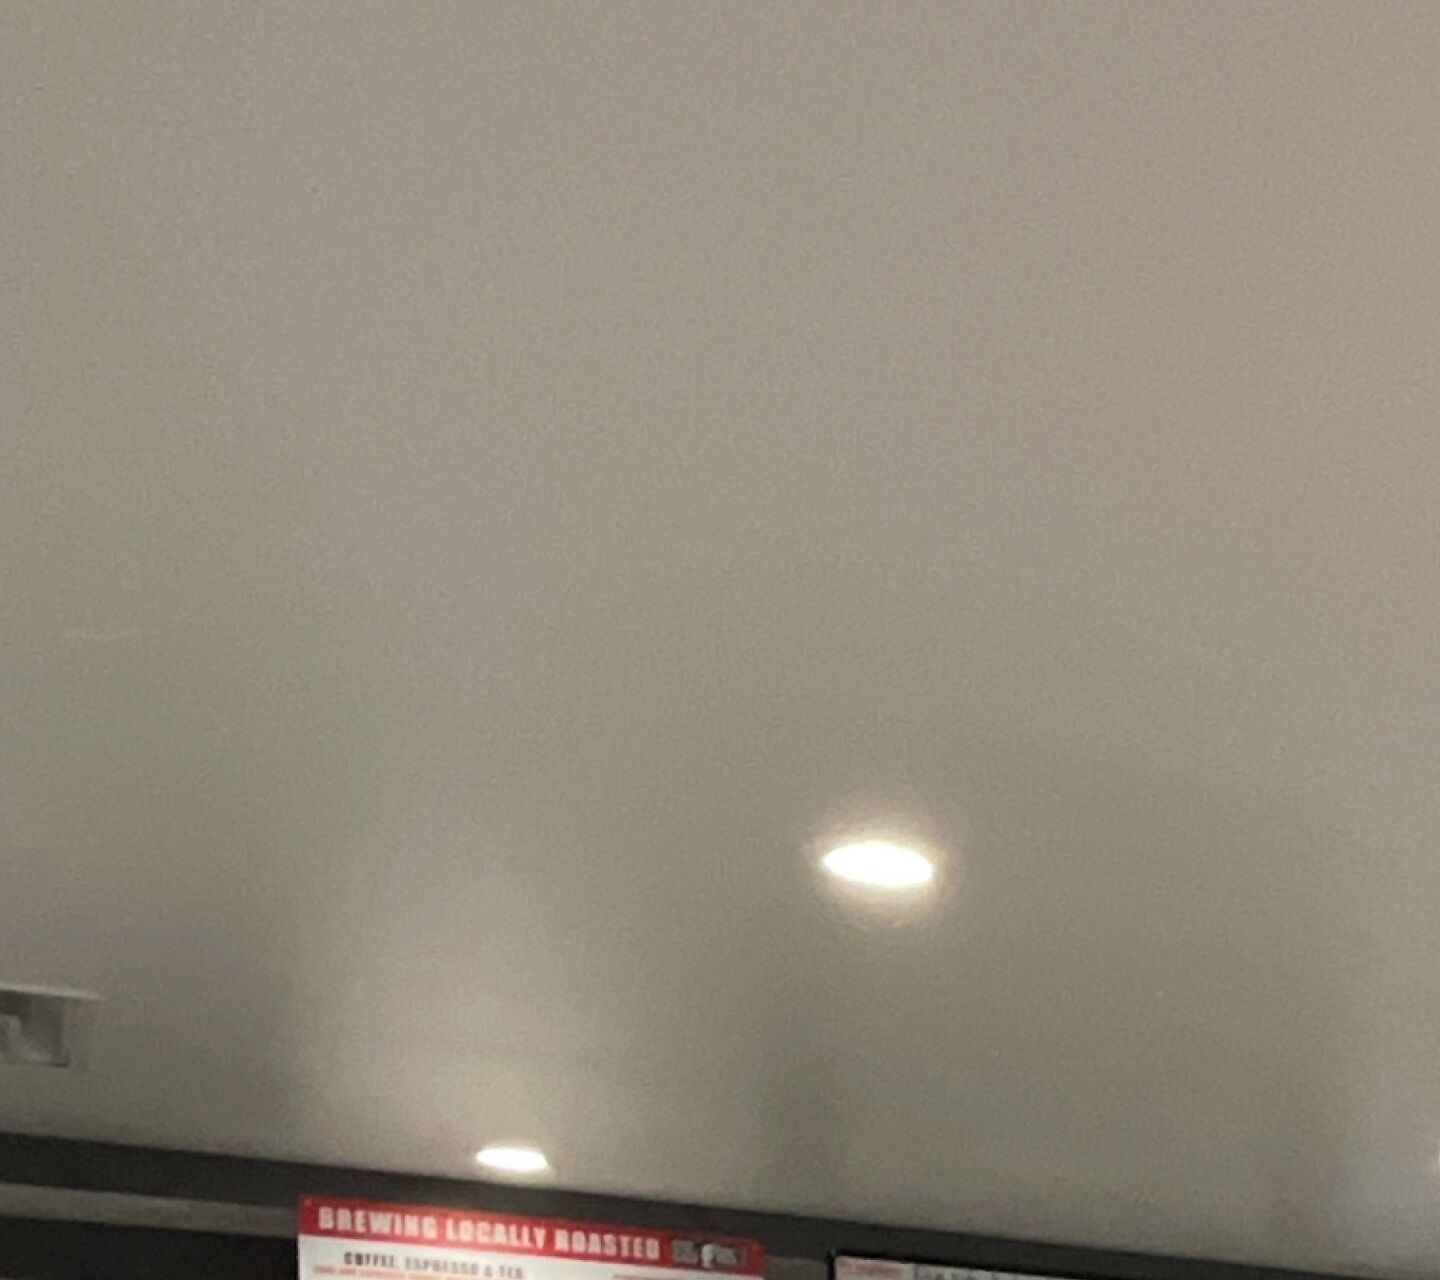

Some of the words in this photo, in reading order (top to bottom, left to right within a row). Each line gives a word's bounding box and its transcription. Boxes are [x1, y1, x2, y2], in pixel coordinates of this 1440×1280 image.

[318, 1206, 438, 1240] BREWING
[445, 1218, 547, 1249] LOCALLY
[554, 1228, 660, 1260] ROASTED
